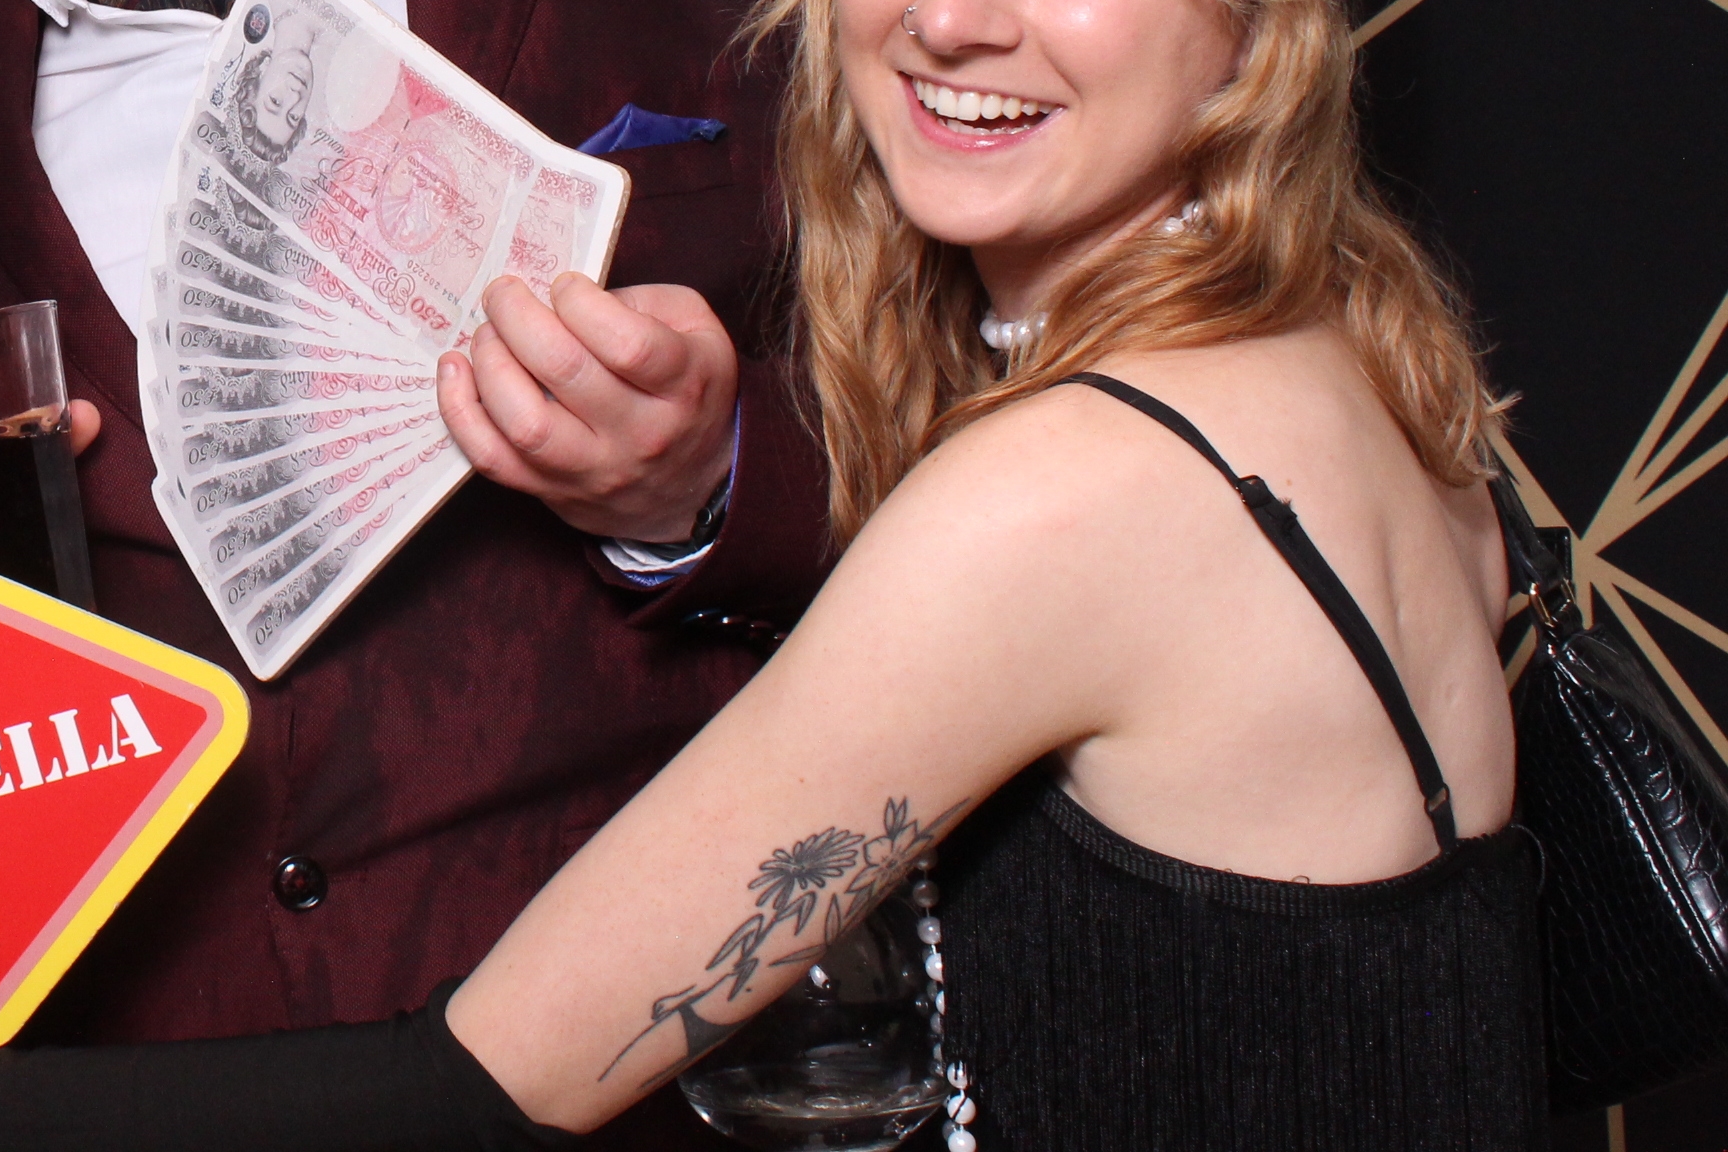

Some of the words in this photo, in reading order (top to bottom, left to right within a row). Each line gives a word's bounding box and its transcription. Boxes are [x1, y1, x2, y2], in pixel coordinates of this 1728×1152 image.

[196, 122, 232, 153] £50
[311, 128, 378, 192] Pounds
[312, 172, 369, 223] FIFTY
[189, 210, 224, 236] £50
[283, 185, 353, 252] England
[181, 250, 221, 272] £50
[407, 259, 441, 290] 202220
[354, 250, 416, 315] Bank
[442, 288, 460, 305] N34
[183, 289, 221, 309] £50
[411, 297, 452, 331] £50
[181, 331, 218, 348] £50
[181, 388, 217, 408] £50
[188, 442, 221, 465] £50
[197, 485, 231, 513] £50
[216, 531, 249, 564] £50
[227, 571, 260, 605] £50
[255, 609, 287, 646] £50
